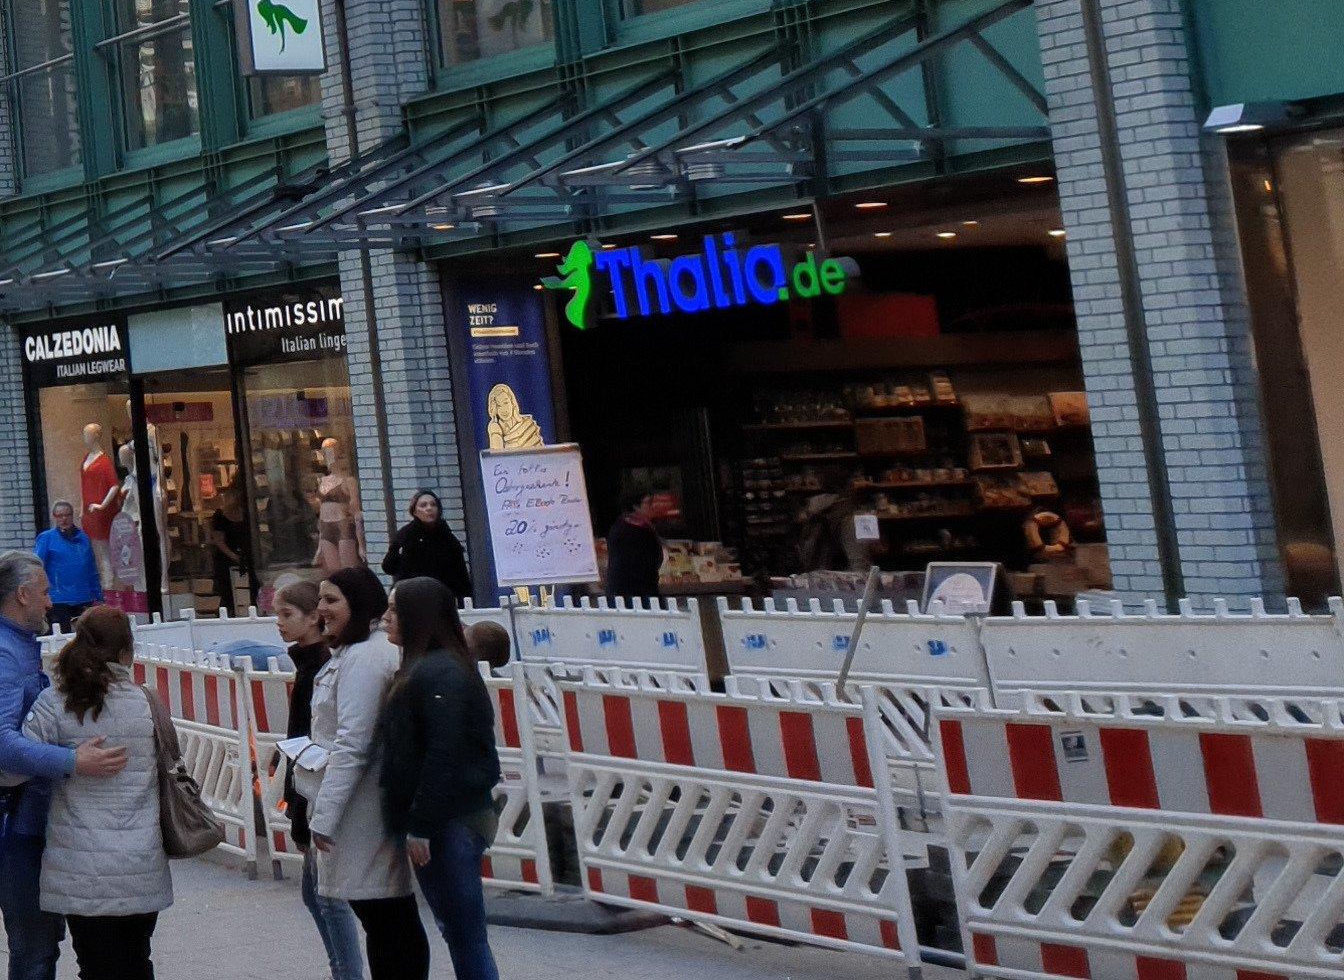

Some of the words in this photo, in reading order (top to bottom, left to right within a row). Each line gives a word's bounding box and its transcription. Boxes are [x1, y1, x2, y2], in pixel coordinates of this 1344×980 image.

[595, 231, 849, 320] Thalia.de
[25, 325, 121, 362] CALZEDONIA
[280, 337, 317, 354] Italian
[56, 362, 86, 378] ITALIAN
[86, 357, 126, 376] LEGWEAR
